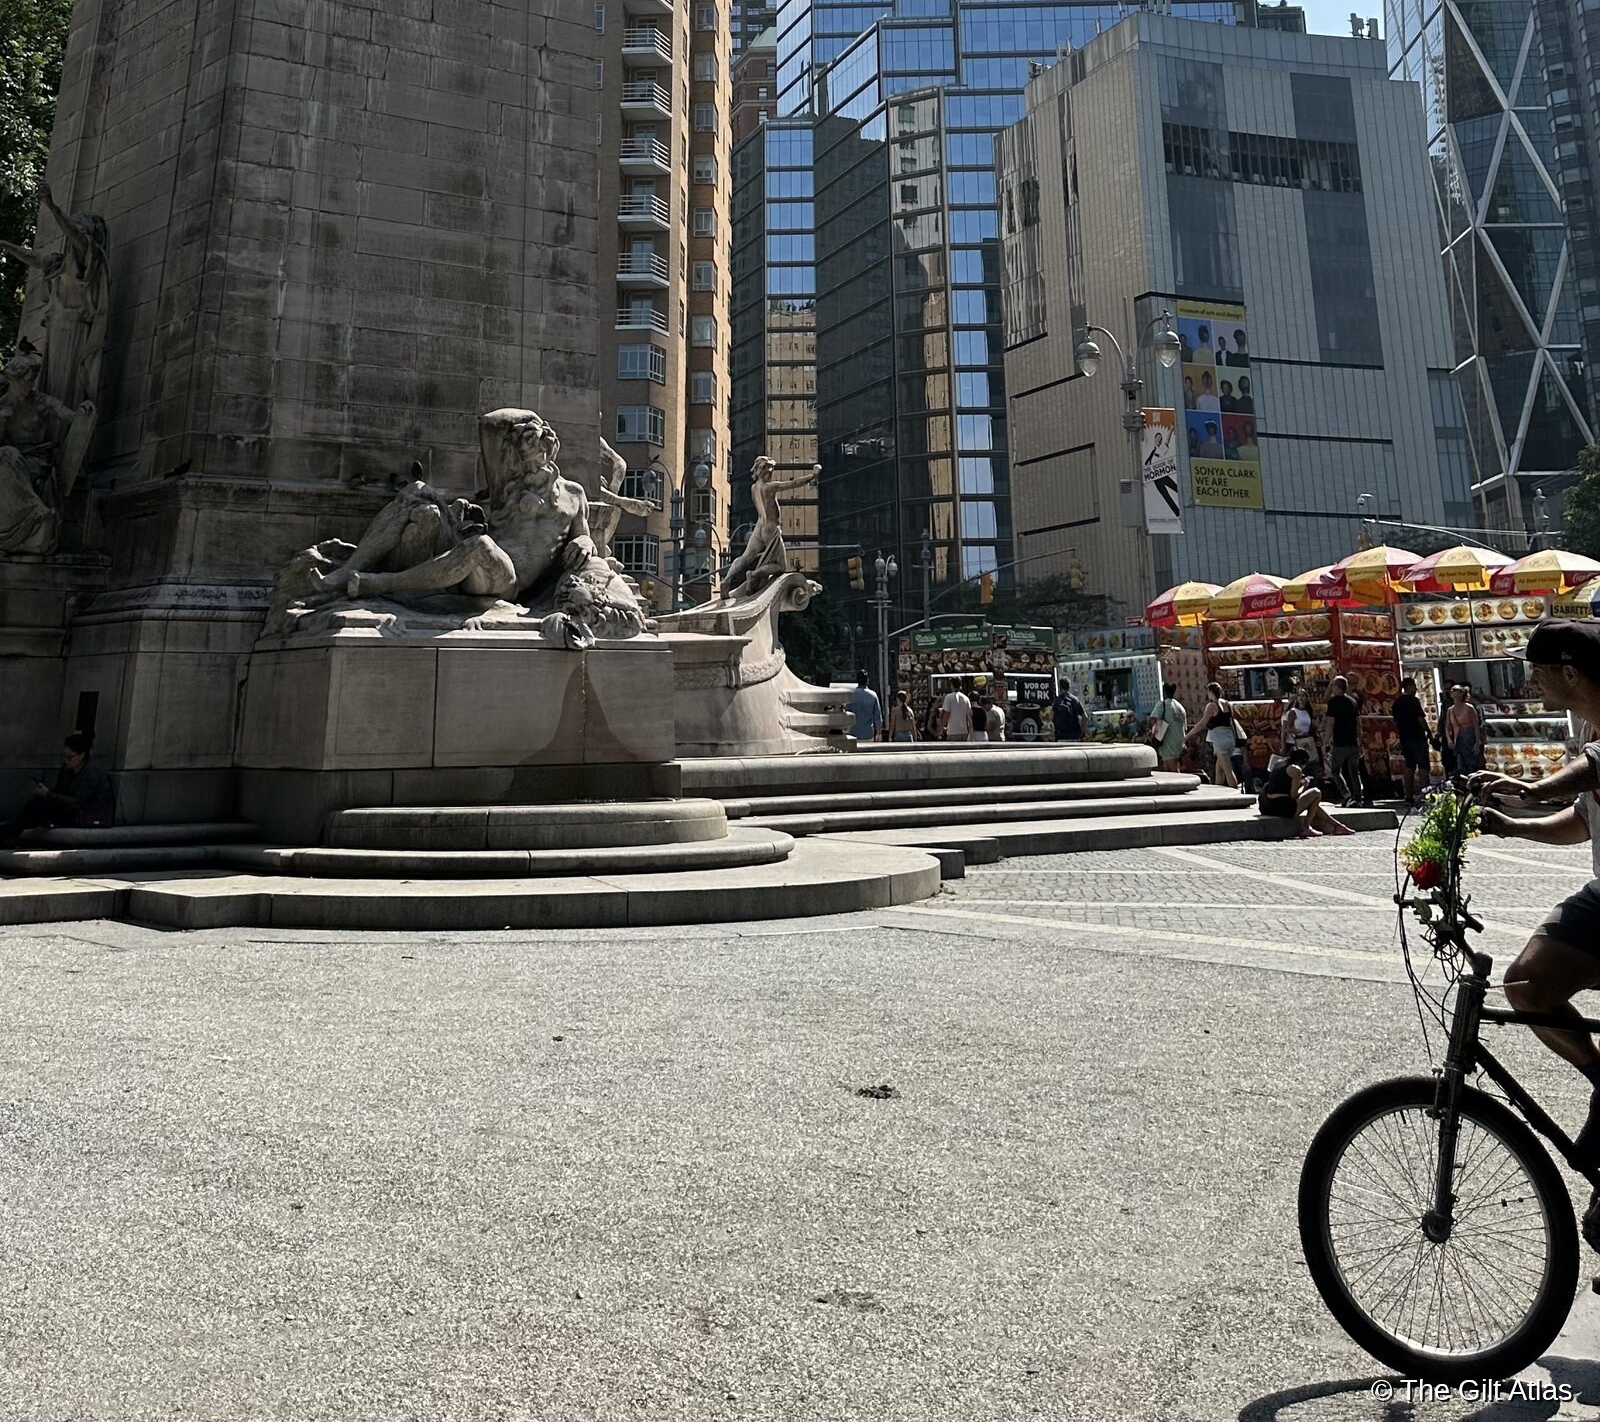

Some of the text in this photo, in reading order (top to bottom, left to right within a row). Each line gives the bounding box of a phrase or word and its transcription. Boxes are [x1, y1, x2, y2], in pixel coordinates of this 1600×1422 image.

[1143, 463, 1177, 481] MORMON
[1194, 465, 1226, 477] SONYA
[1194, 476, 1229, 487] WE ARE
[1196, 486, 1251, 499] EACH OTHER
[1553, 604, 1588, 615] SABRETT
[1040, 682, 1050, 690] OF
